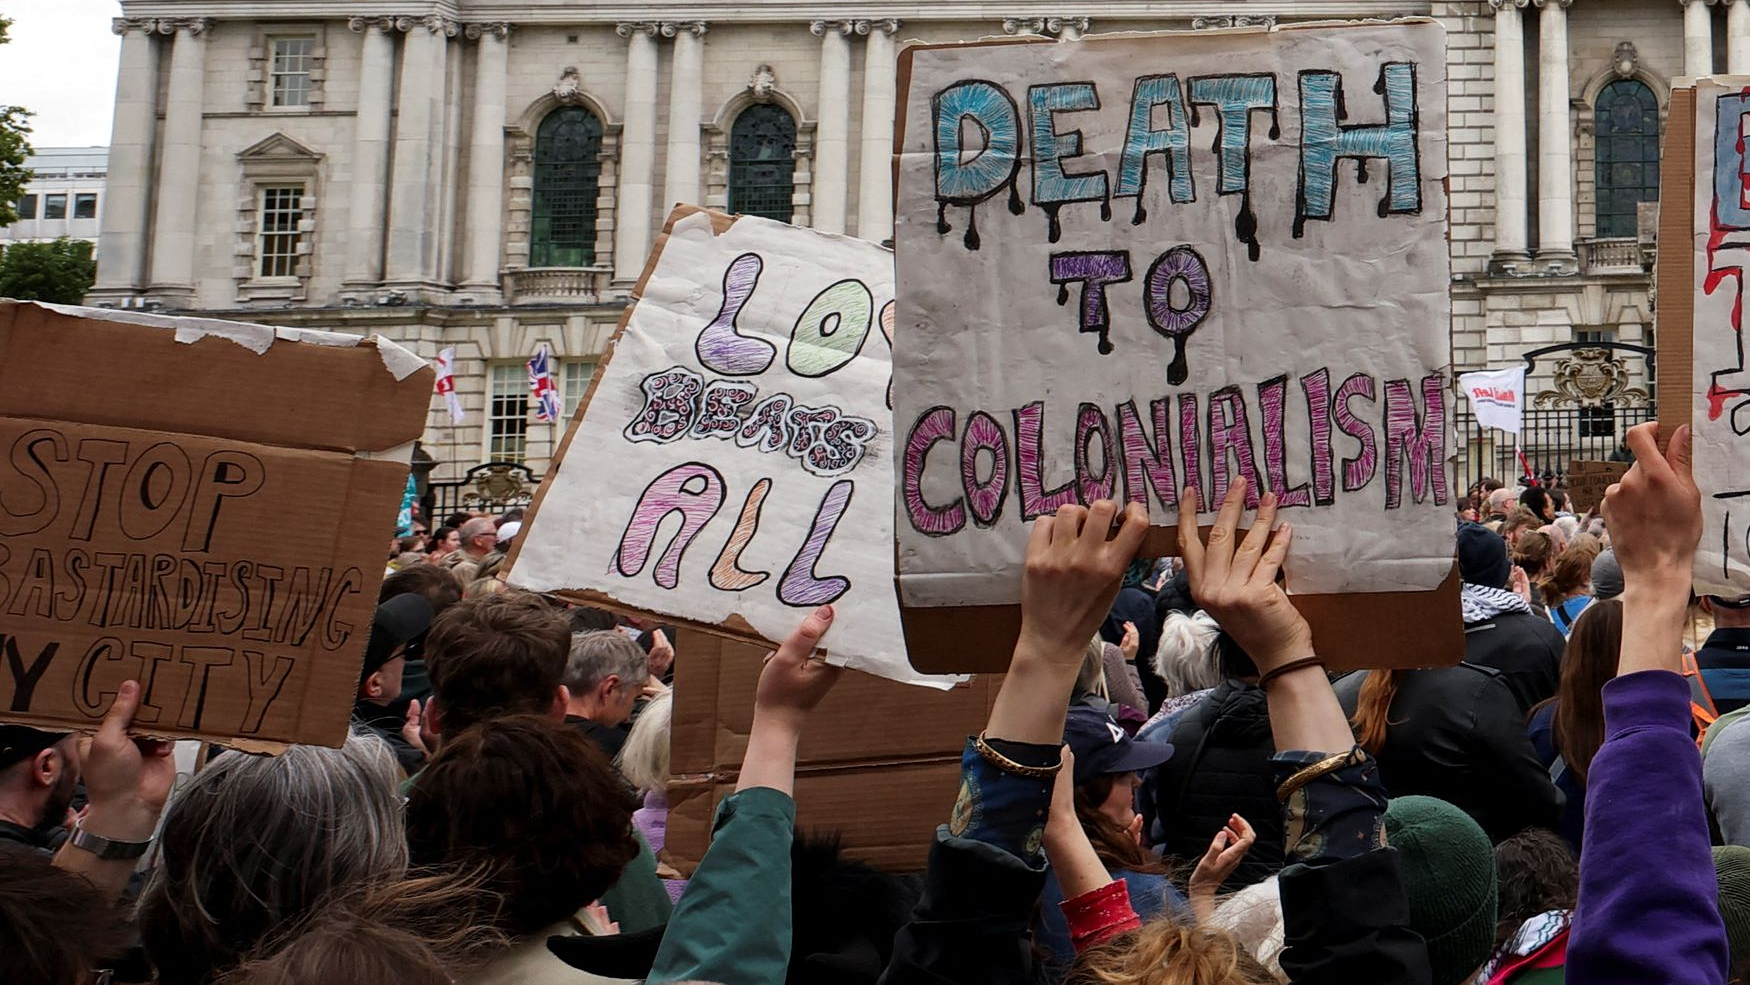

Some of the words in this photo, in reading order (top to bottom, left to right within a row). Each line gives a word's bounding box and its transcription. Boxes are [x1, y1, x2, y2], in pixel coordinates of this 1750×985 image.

[931, 61, 1423, 239] DEATH
[695, 252, 894, 411] LO
[1049, 244, 1214, 356] TO
[622, 365, 878, 477] BEATS
[902, 367, 1448, 535] COLONIALISM
[0, 428, 266, 553] STOP
[612, 460, 855, 607] ALL
[72, 636, 295, 734] CITY
